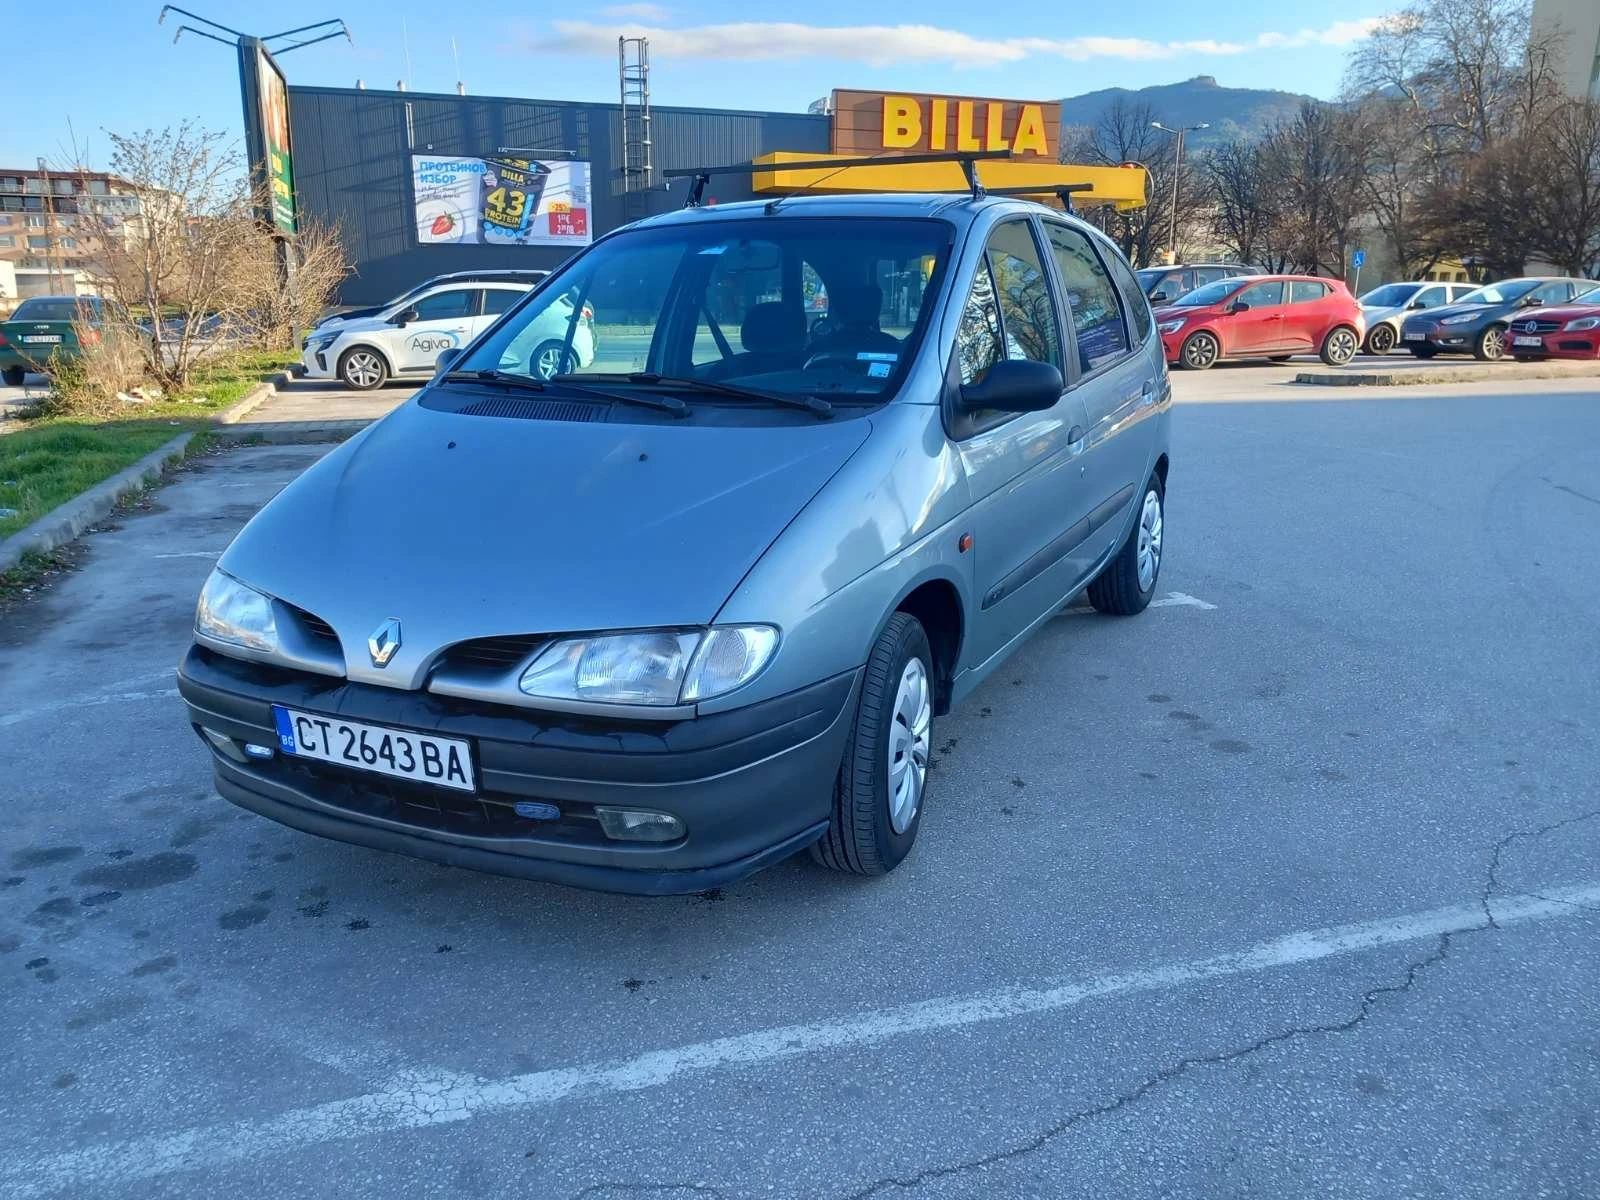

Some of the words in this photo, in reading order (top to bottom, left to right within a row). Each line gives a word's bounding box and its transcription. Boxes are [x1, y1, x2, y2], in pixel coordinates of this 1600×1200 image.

[882, 96, 1048, 155] BILLA
[420, 161, 487, 174] ПРОТЕИНОВ
[420, 174, 457, 184] ИЗБОР
[501, 168, 524, 183] BILLA
[487, 187, 525, 216] 43
[484, 208, 521, 225] PROTEIN
[411, 337, 450, 352] Agiva
[281, 734, 294, 747] BG
[296, 716, 331, 755] CT
[338, 726, 417, 773] 2643
[420, 740, 467, 784] BA
